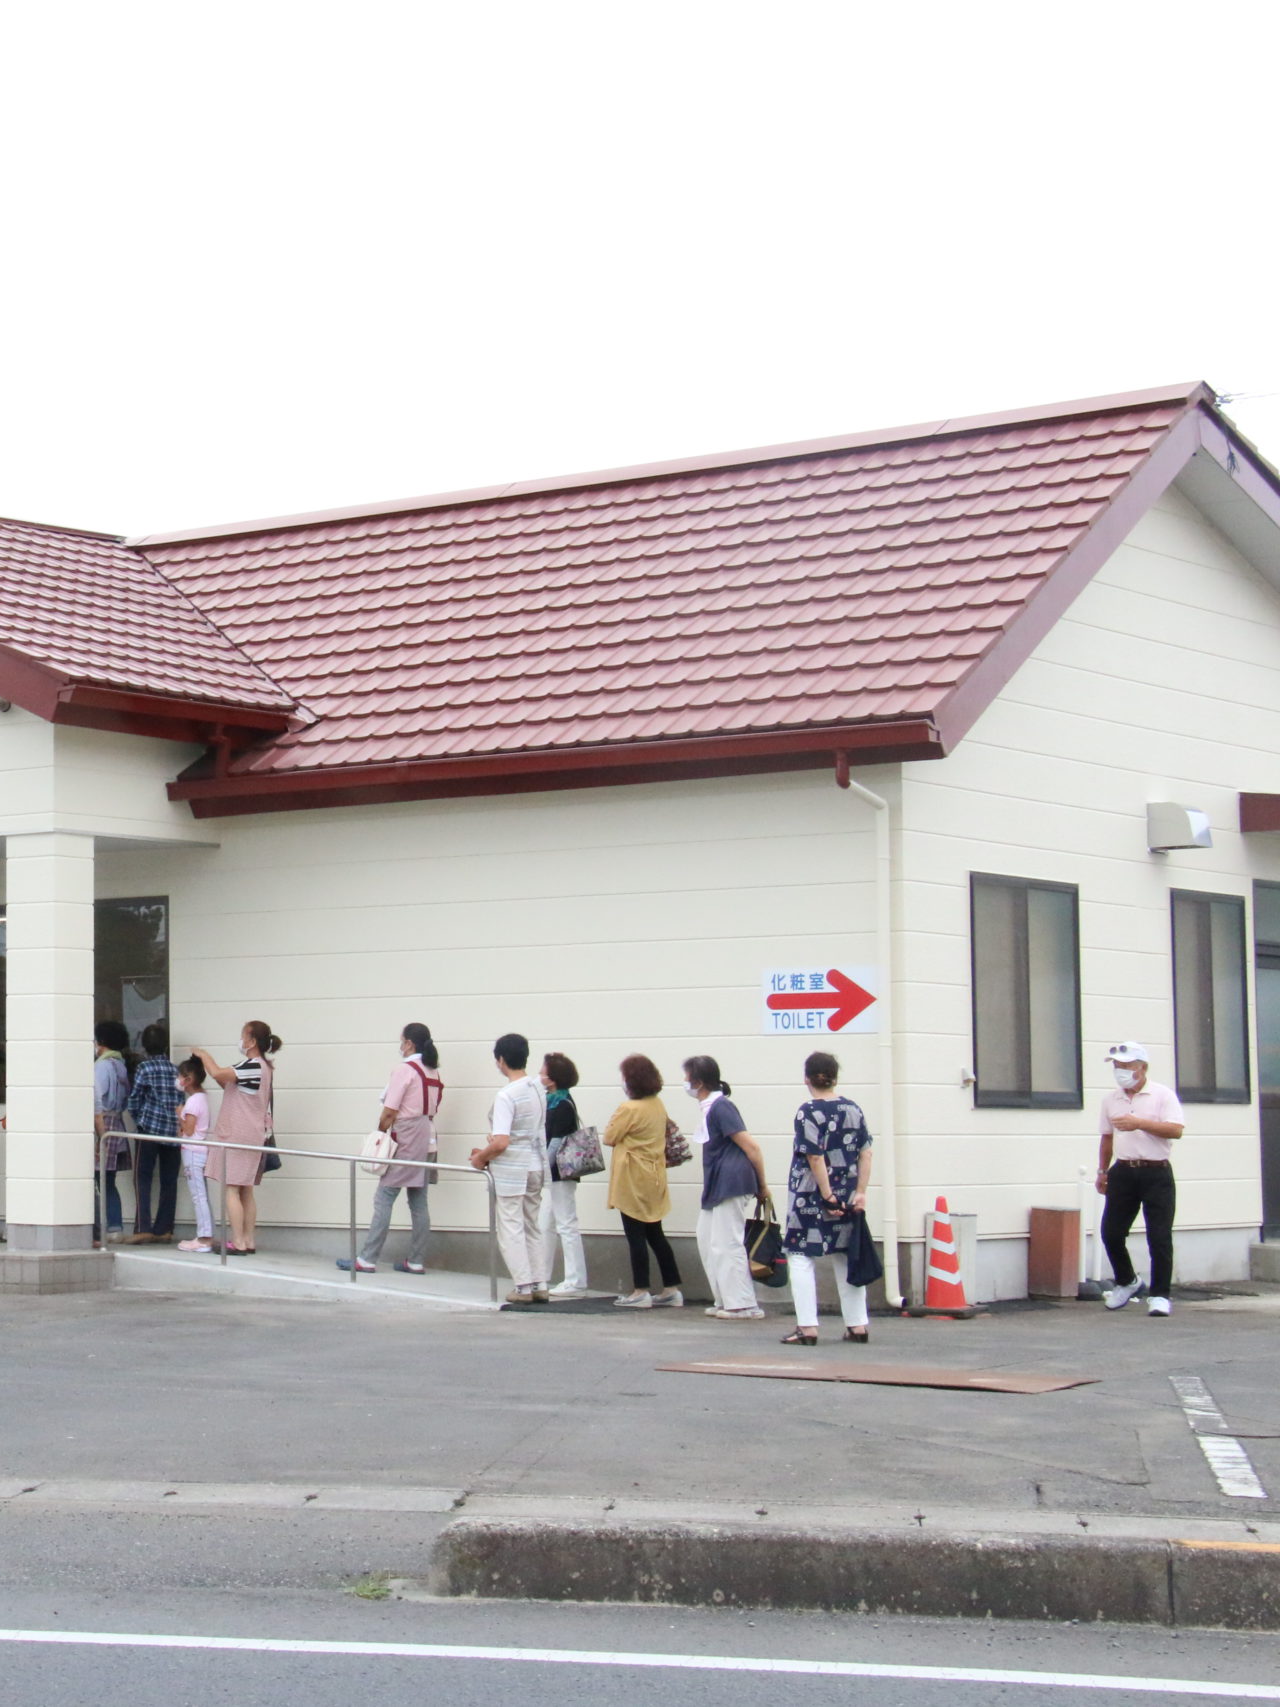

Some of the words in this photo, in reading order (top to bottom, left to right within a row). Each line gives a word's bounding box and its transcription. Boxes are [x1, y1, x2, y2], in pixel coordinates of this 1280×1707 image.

[771, 973, 825, 991] 化粧室
[771, 1011, 825, 1029] TOILET
